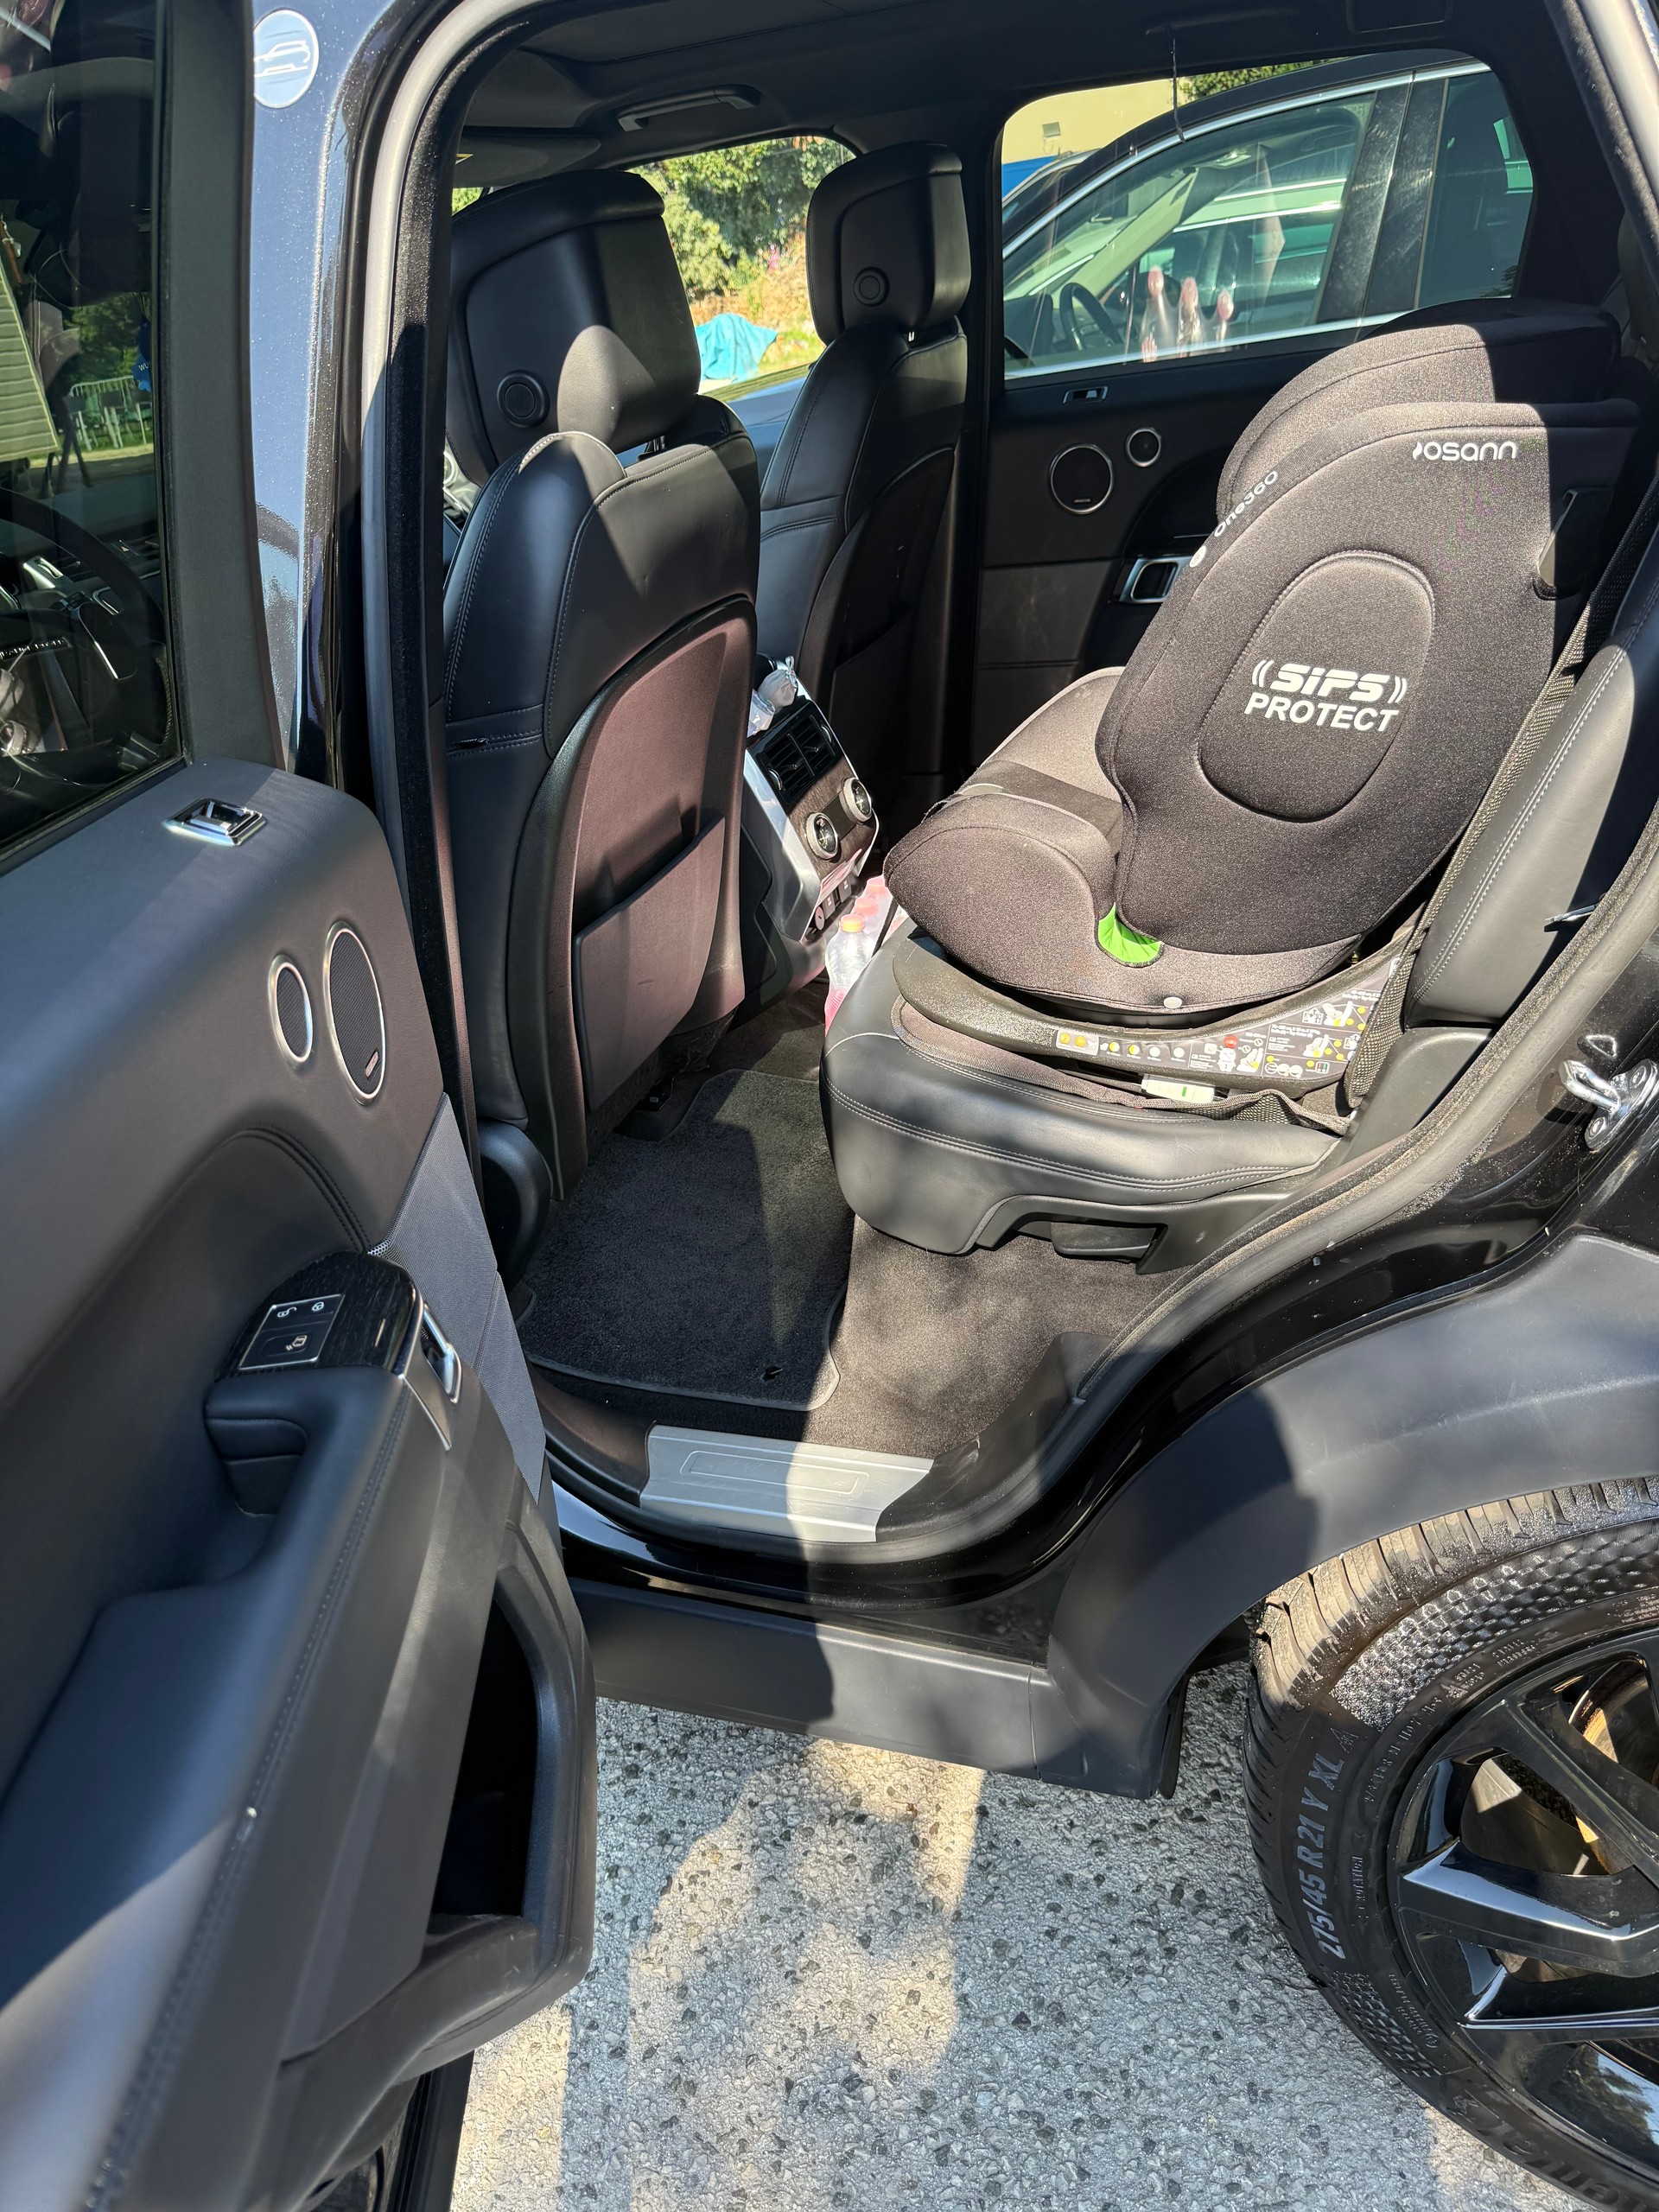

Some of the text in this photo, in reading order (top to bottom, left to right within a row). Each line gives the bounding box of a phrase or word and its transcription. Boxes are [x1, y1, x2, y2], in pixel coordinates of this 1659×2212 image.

[1244, 691, 1400, 733] PROTECT
[1307, 1751, 1345, 1792] XL
[1300, 1785, 1330, 1812] Y
[1298, 1868, 1347, 1961] 275/45
